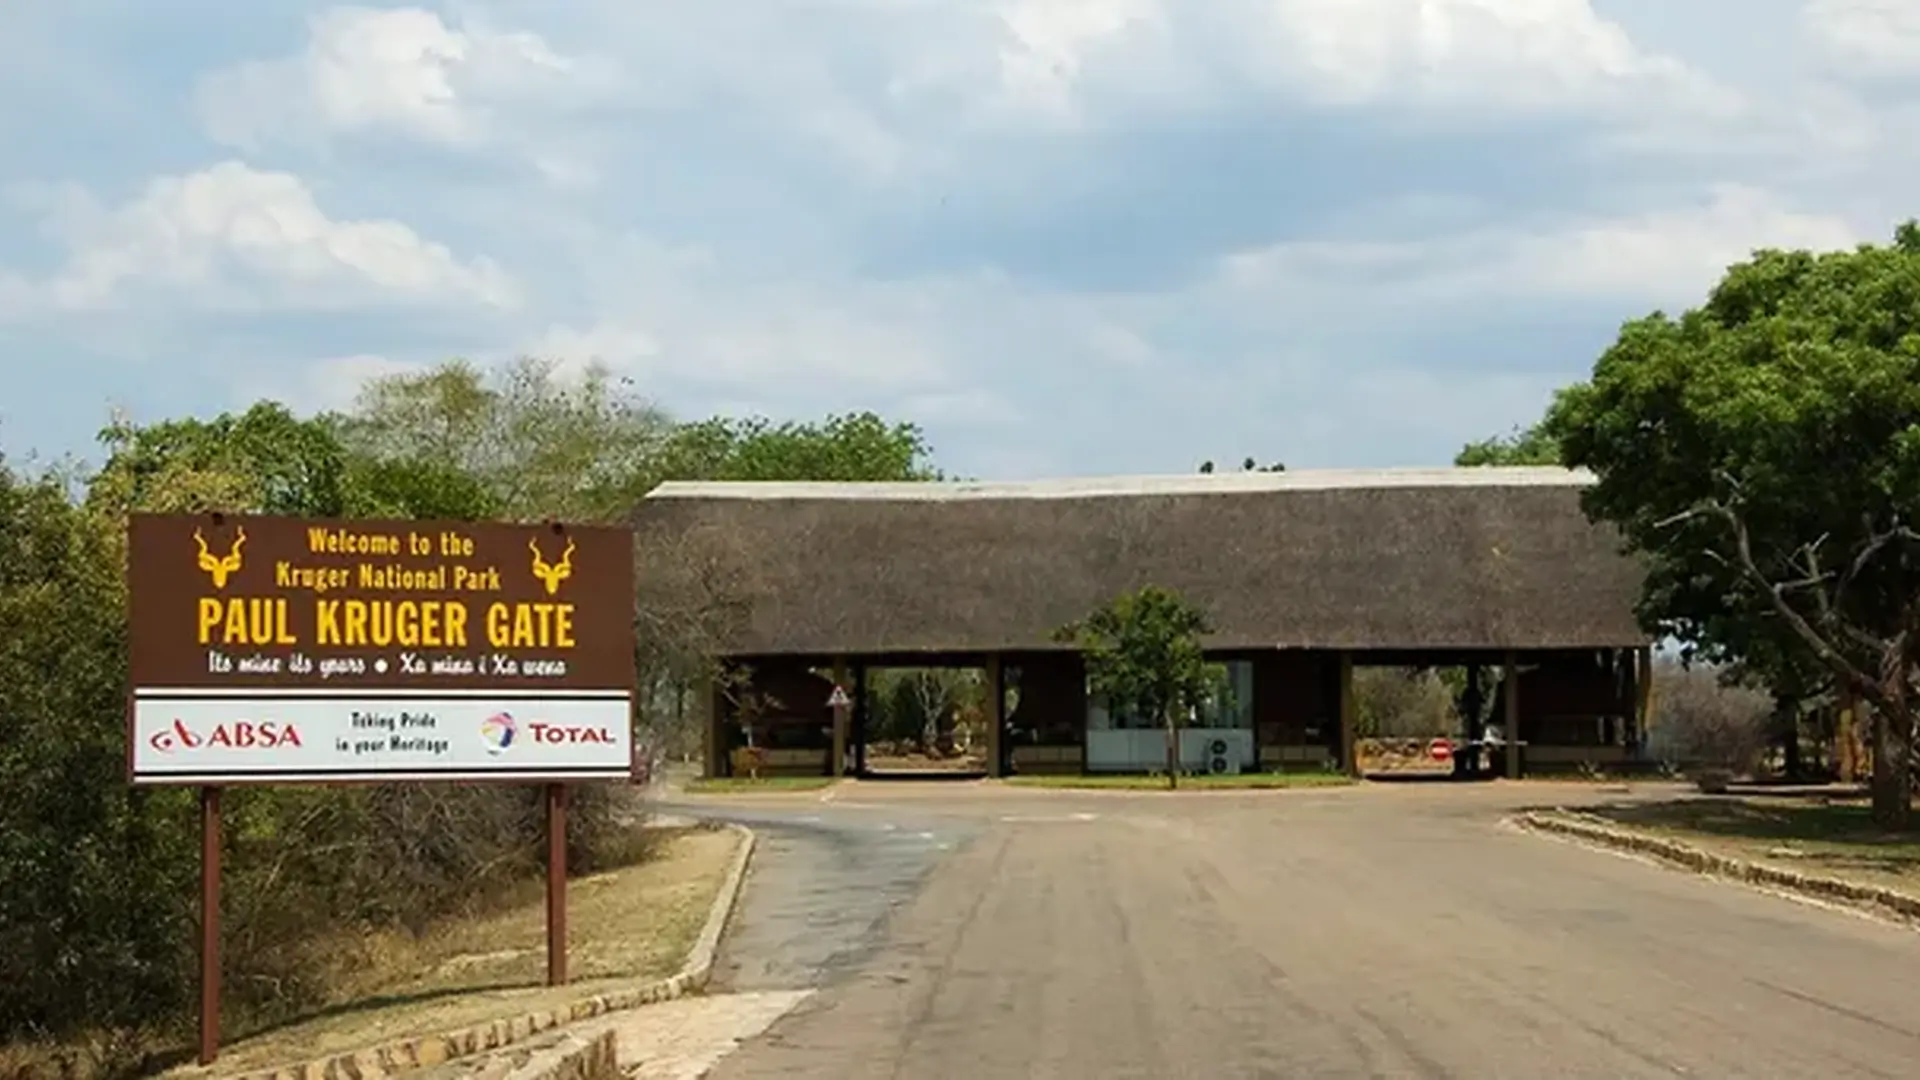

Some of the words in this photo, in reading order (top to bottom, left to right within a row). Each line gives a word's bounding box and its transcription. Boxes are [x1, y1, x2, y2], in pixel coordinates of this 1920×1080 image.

[308, 527, 400, 555] Welcome
[409, 531, 431, 556] to
[440, 531, 475, 556] the
[276, 560, 350, 593] Kruger
[359, 563, 446, 590] National
[453, 565, 501, 591] Park
[199, 598, 297, 645] PAUL
[316, 600, 468, 648] KRUGER
[487, 603, 575, 648] GATE
[238, 653, 281, 673] mine
[319, 657, 366, 679] yours
[206, 721, 303, 748] ABSA
[352, 712, 395, 731] Taking
[401, 712, 436, 729] Pride
[336, 737, 349, 752] in
[355, 741, 384, 755] your
[390, 735, 449, 755] Heritage
